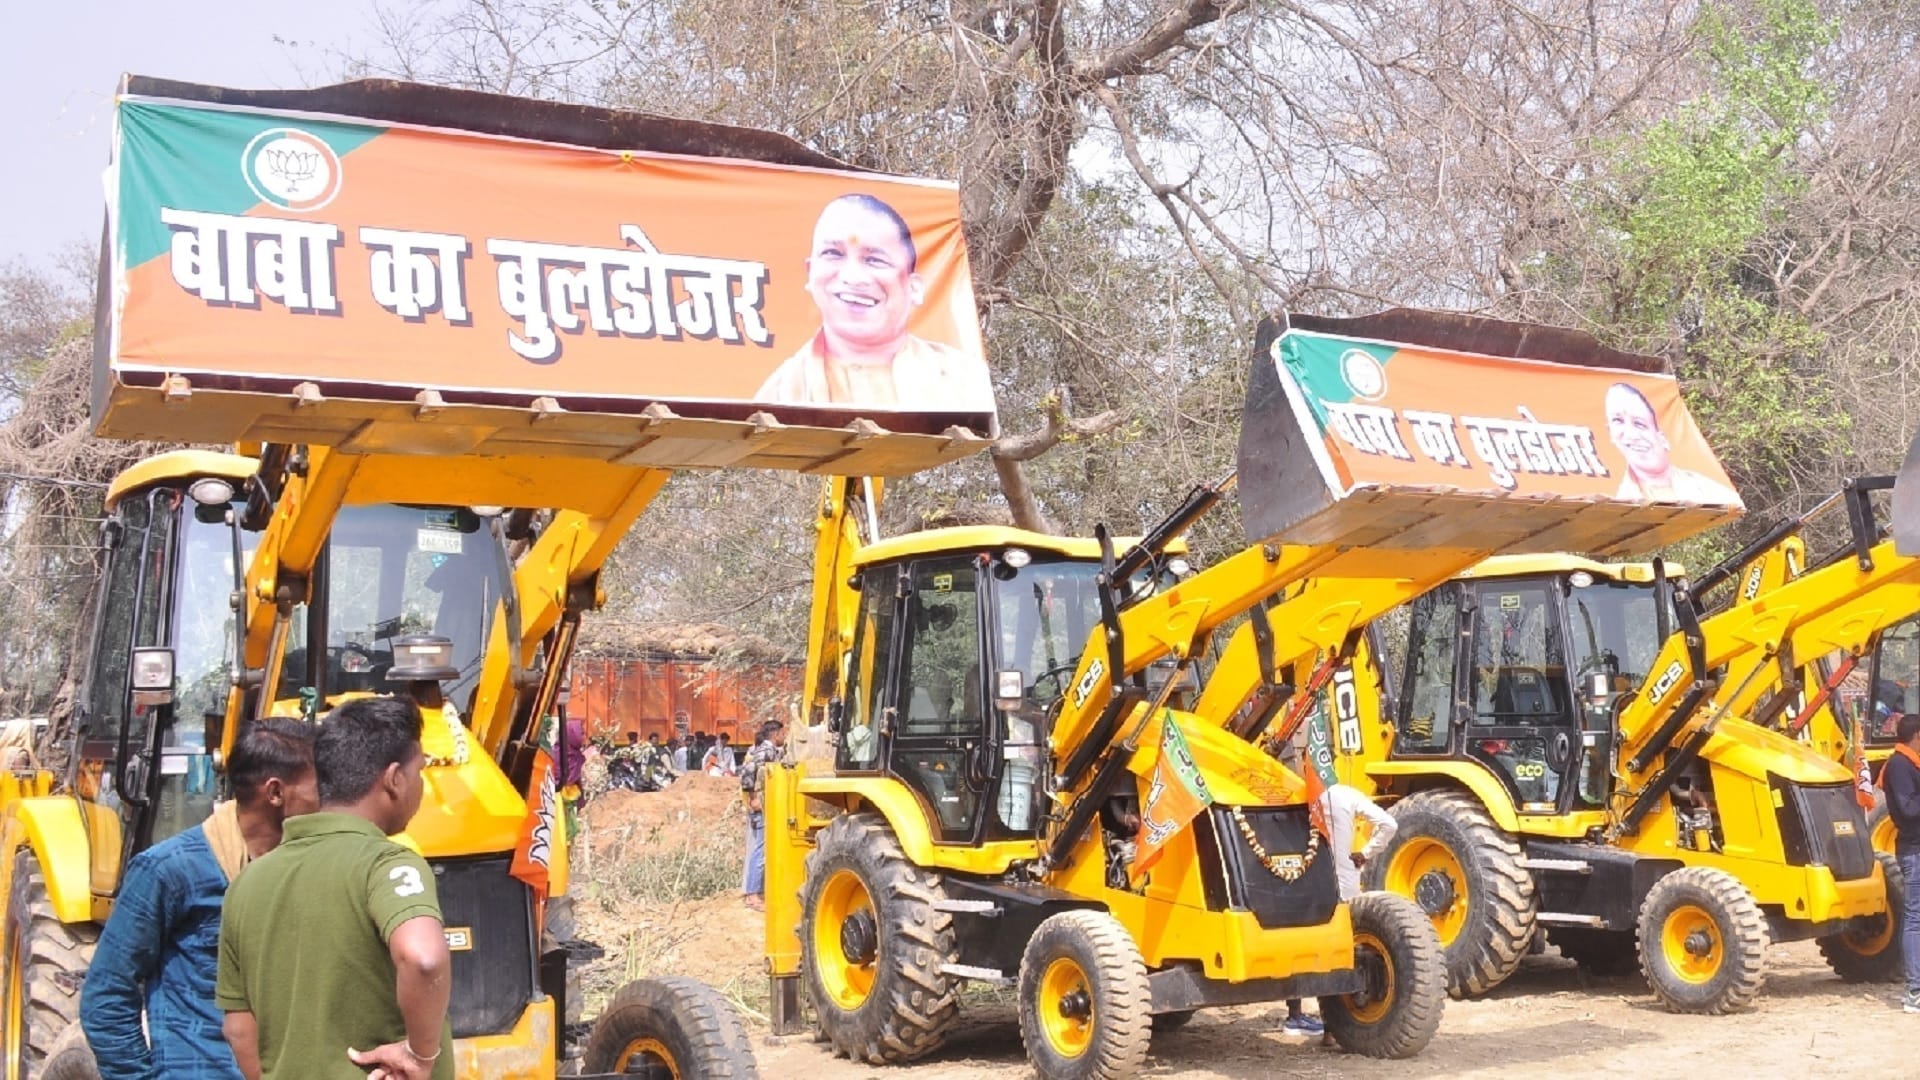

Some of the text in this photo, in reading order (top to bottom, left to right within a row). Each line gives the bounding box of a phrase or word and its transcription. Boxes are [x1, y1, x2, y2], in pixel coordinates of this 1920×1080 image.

[161, 207, 773, 362] बाबा का बुलडोजर
[1319, 399, 1608, 488] बाबा का बुलडोजर
[1075, 659, 1103, 708] JCB
[1650, 661, 1684, 703] JCB
[1515, 764, 1543, 777] eco
[389, 865, 425, 897] 3
